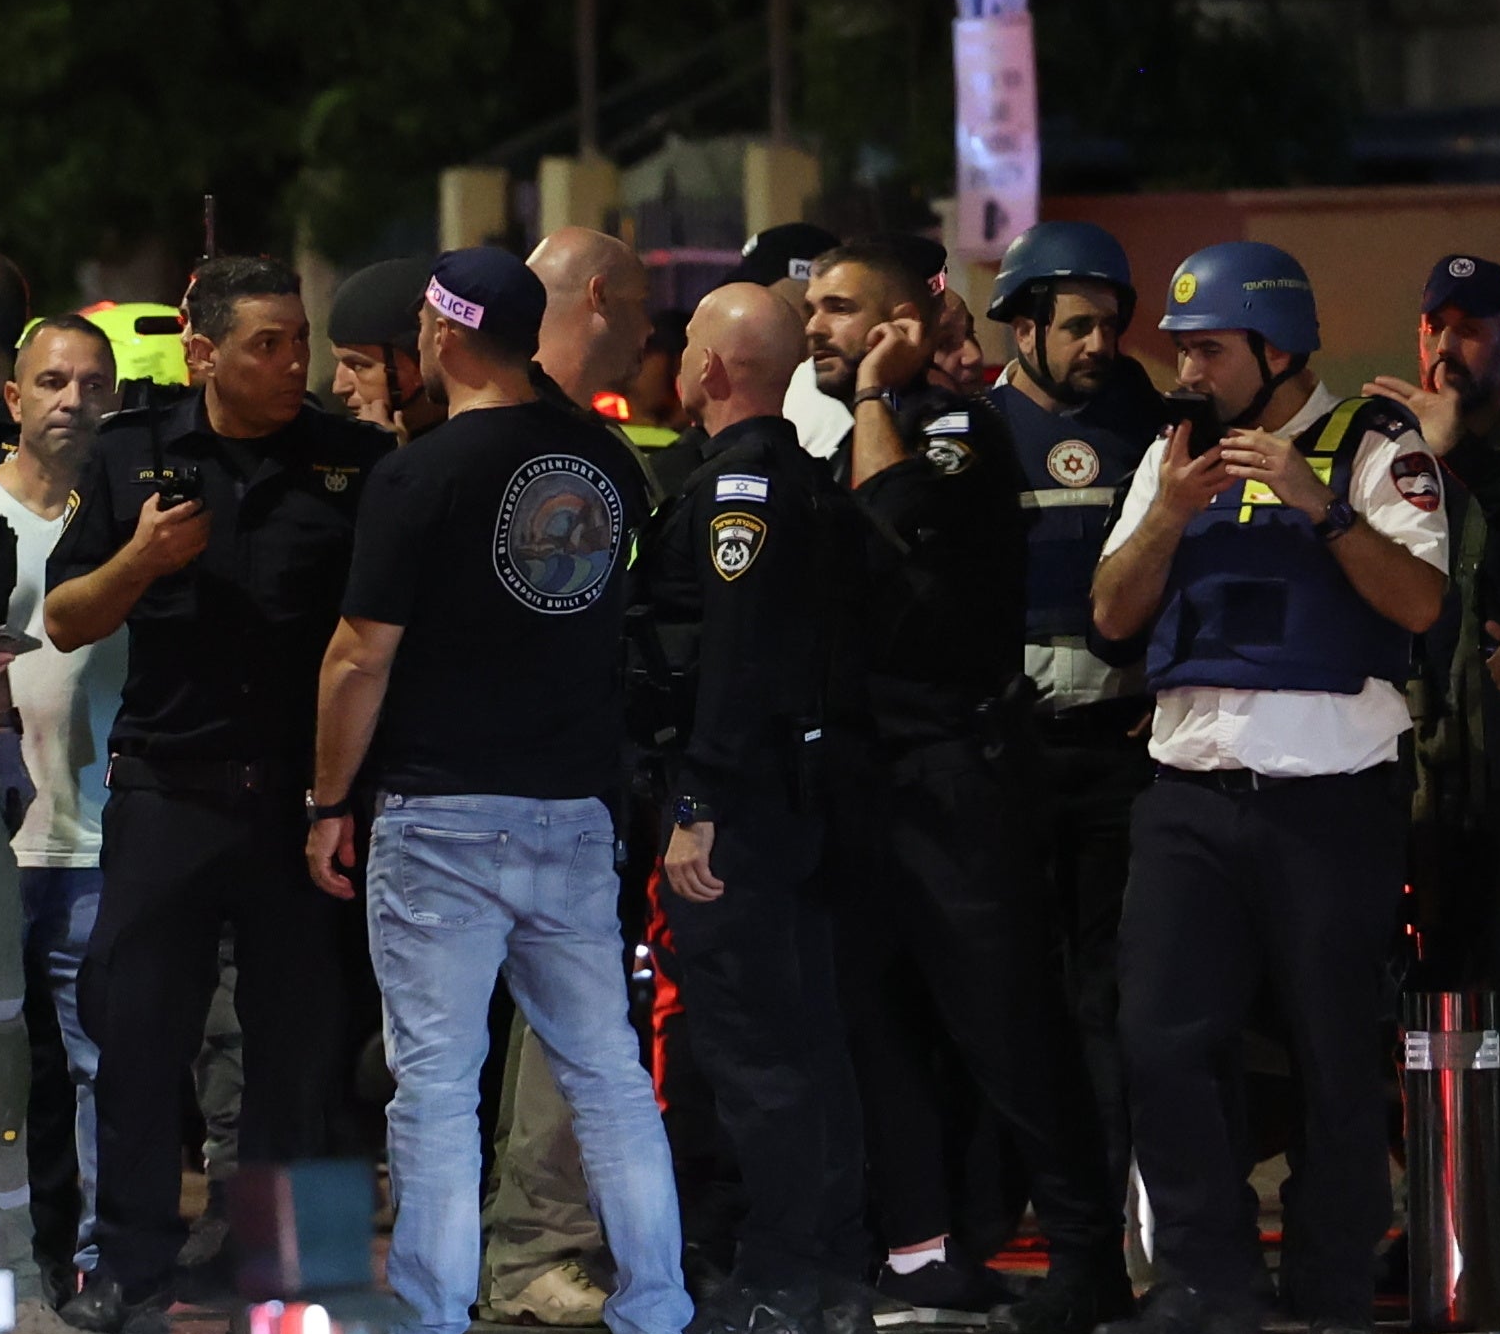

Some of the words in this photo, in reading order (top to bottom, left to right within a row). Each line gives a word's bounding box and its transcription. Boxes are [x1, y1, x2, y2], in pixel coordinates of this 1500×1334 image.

[497, 476, 526, 555] BILLABONG
[526, 459, 595, 481] ADVENTURE
[597, 479, 620, 544] DIVISION
[546, 597, 580, 608] BUILT
